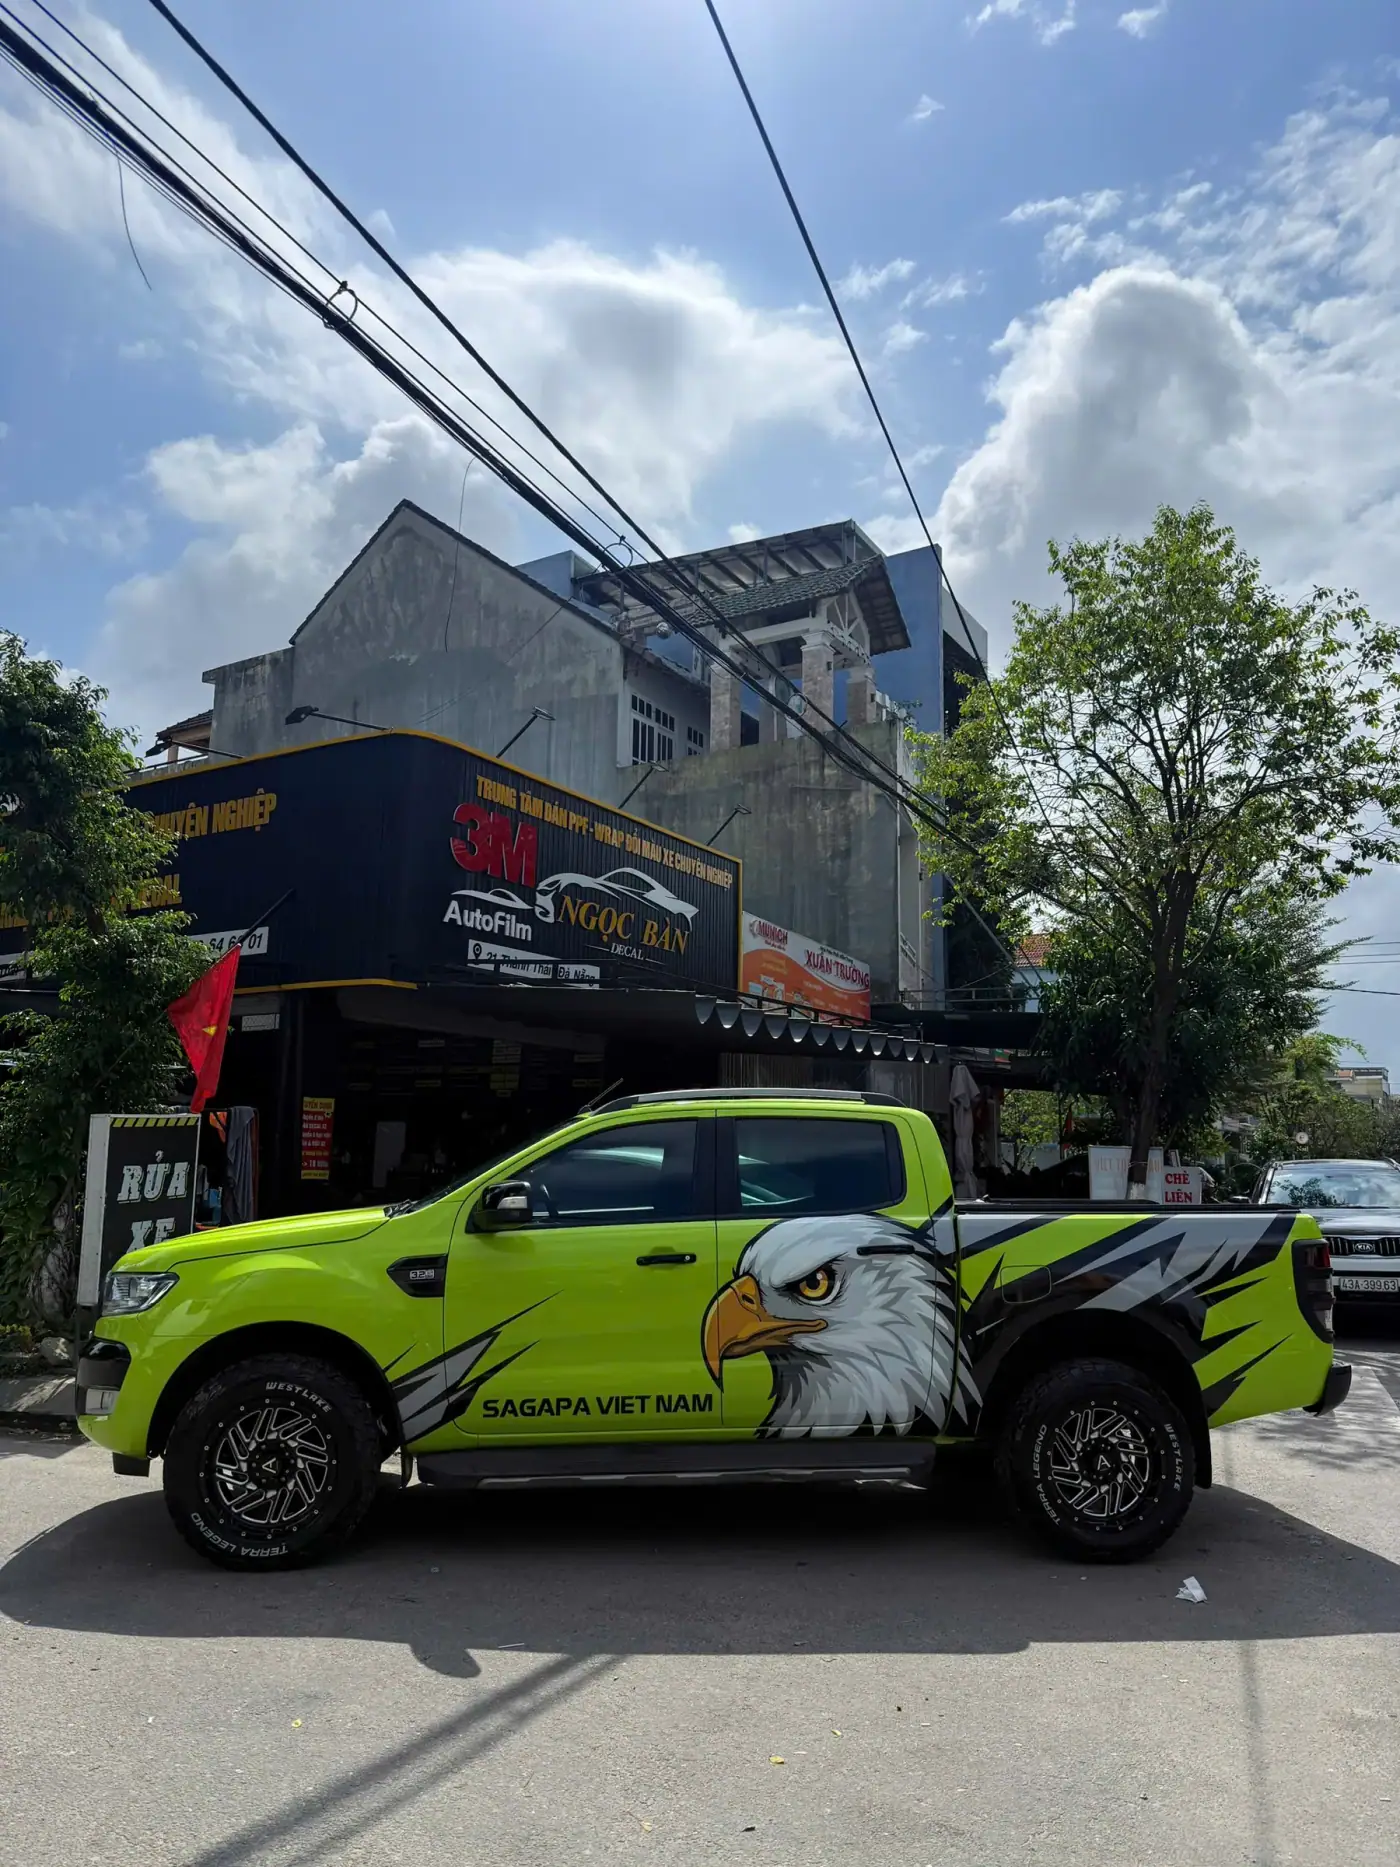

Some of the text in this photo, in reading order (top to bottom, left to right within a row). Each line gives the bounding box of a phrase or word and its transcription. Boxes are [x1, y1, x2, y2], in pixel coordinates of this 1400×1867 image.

[212, 787, 277, 834] NGHIỆP
[476, 774, 517, 810] TRUNG
[519, 790, 544, 819] TÂM
[544, 801, 568, 829] DÁN
[594, 821, 625, 849] WRAP
[662, 847, 674, 868] XE
[450, 802, 538, 888] 3M
[248, 933, 264, 950] 01
[443, 899, 533, 942] AutoFilm
[557, 894, 690, 955] NGỌC BÀN
[610, 942, 645, 961] DECAL
[805, 949, 833, 975] XUÂN
[117, 1150, 190, 1204] RỬA
[1164, 1170, 1190, 1184] CHÈ
[1164, 1189, 1193, 1203] LIÊN
[265, 1381, 332, 1413] WESTLAKE
[482, 1393, 714, 1418] SAGAPA VIET NAM
[1032, 1424, 1061, 1525] TERRA LEGEND
[1163, 1423, 1184, 1492] WESTLAKE
[190, 1512, 289, 1557] TERRA LEGEND
